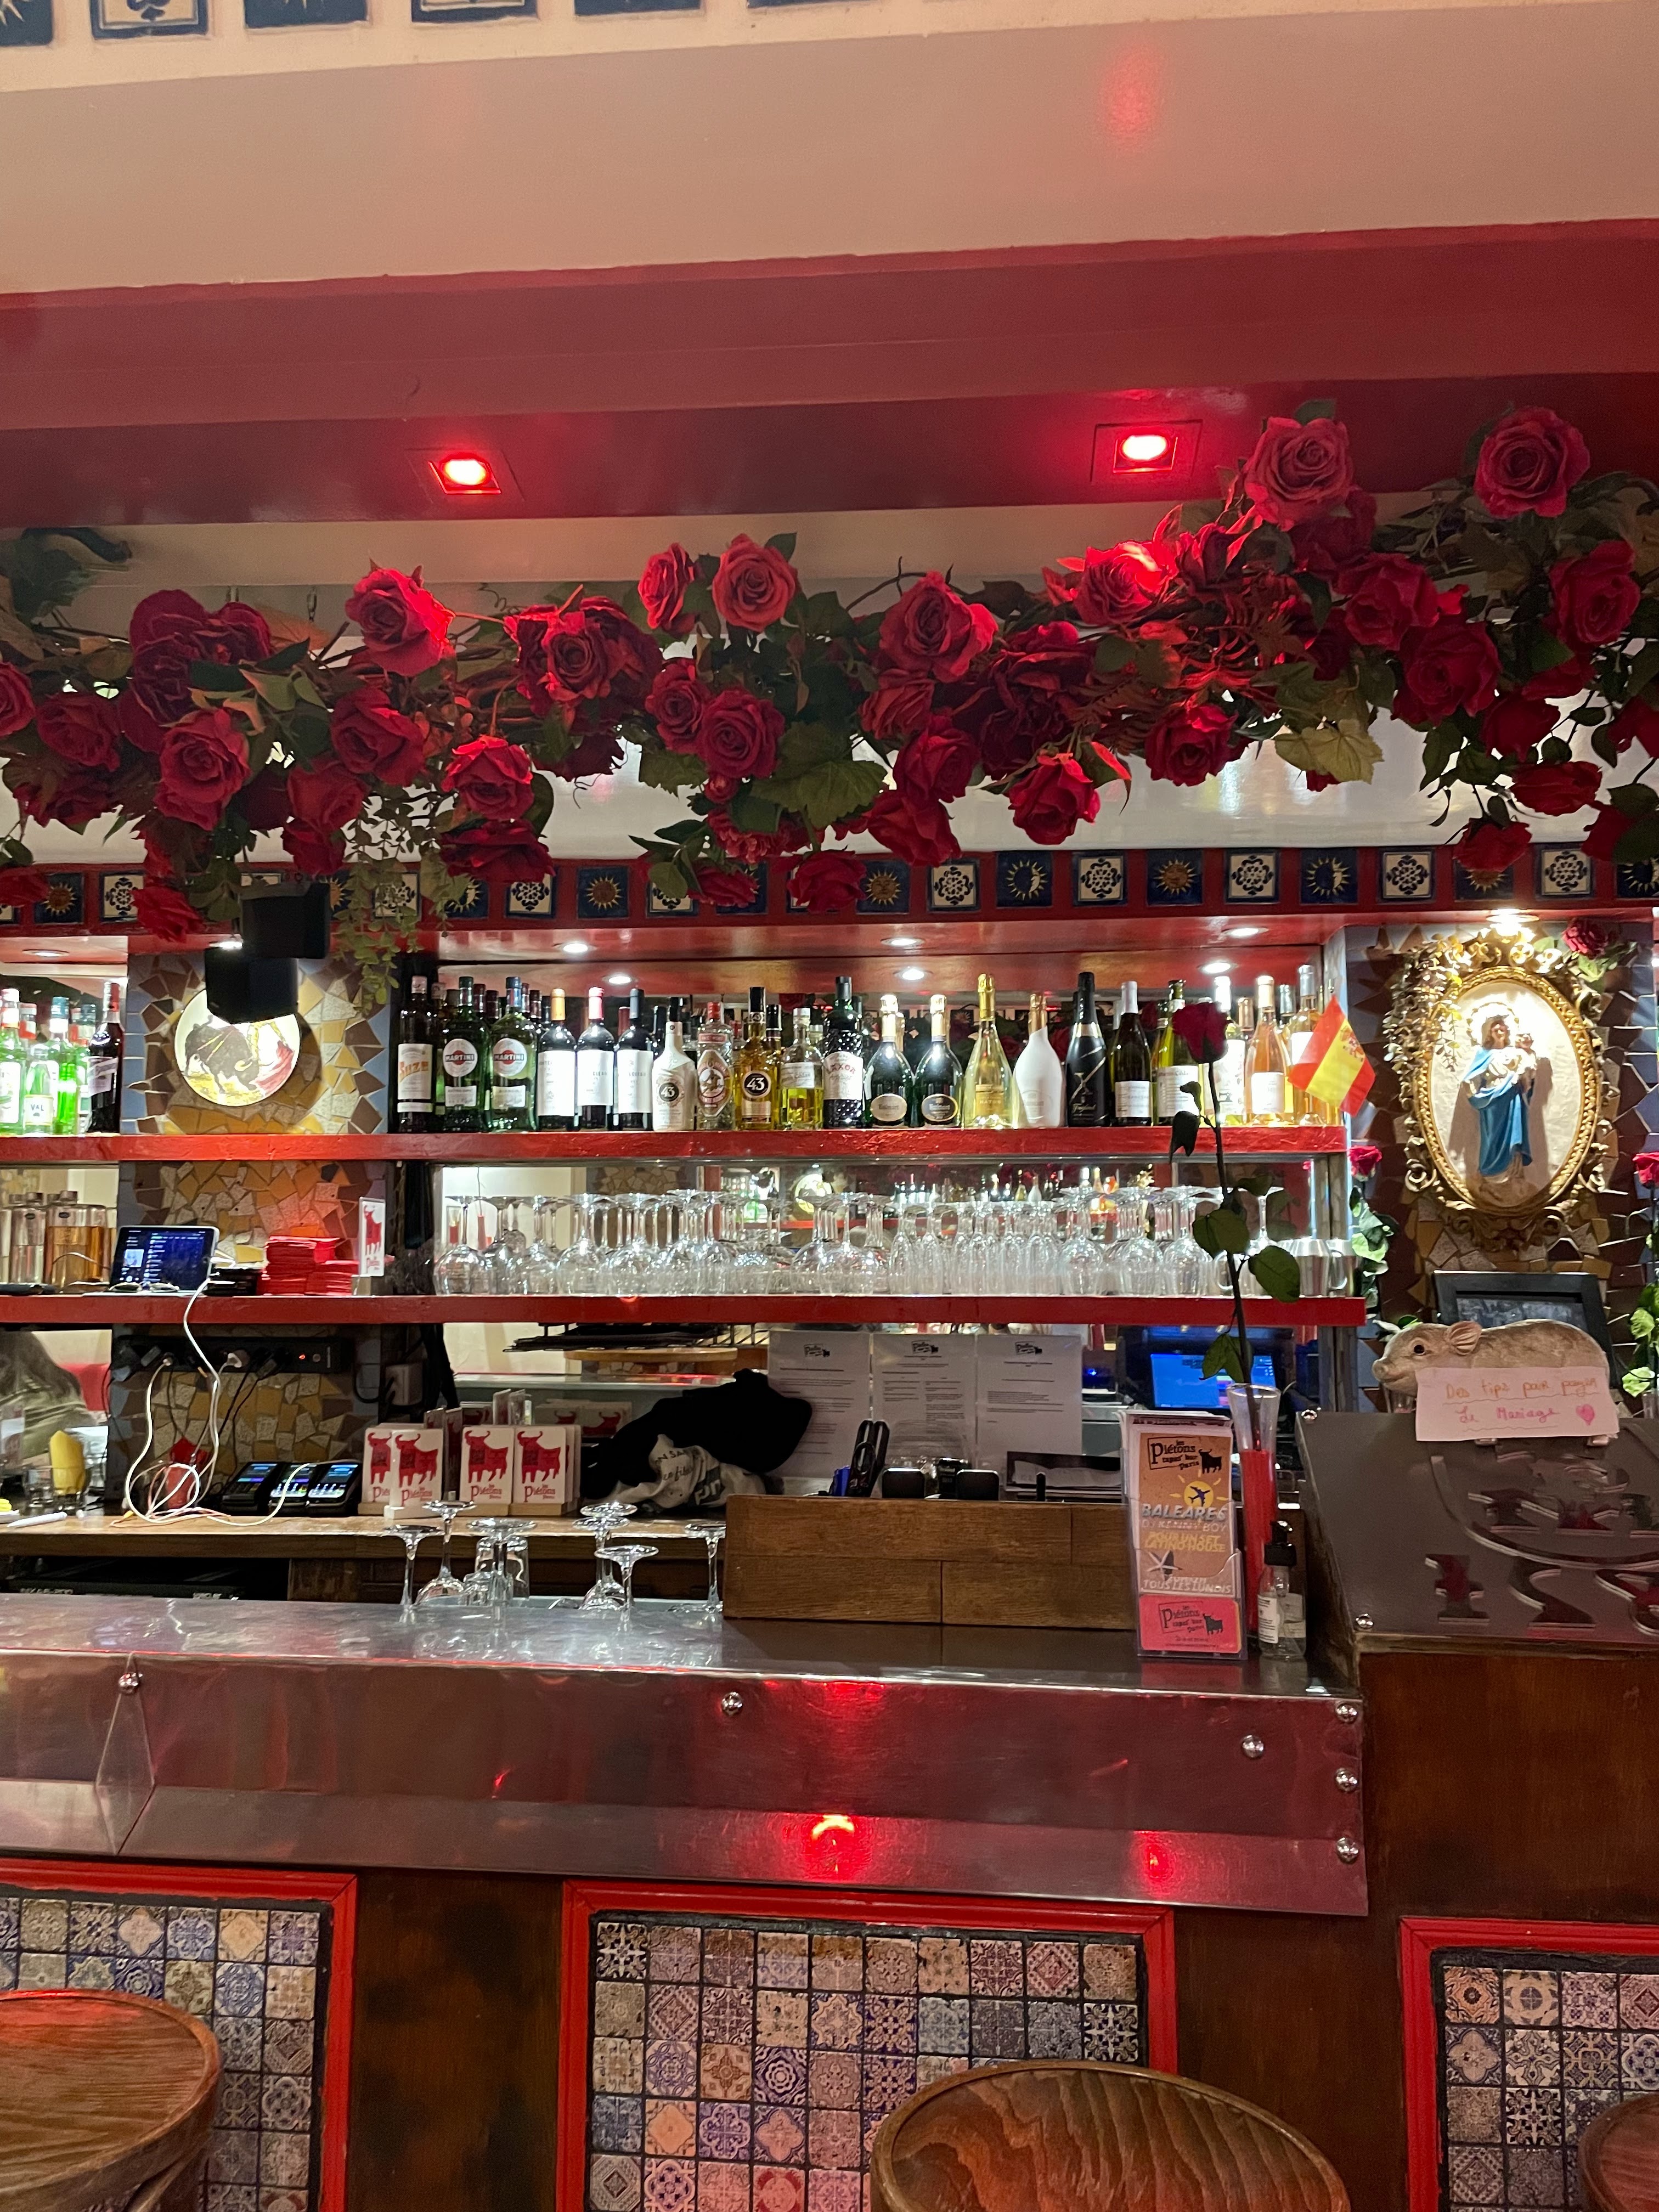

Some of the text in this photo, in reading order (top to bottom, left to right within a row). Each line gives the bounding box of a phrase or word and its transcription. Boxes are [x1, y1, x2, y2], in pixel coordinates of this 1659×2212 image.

[445, 1054, 475, 1062] MARTINI
[747, 1077, 765, 1090] 43
[661, 1086, 675, 1098] 43
[1455, 1406, 1559, 1423] Le Mariage
[1141, 1503, 1228, 1522] BALEARES
[1142, 1579, 1171, 1590] TOUS
[1171, 1579, 1190, 1590] LES
